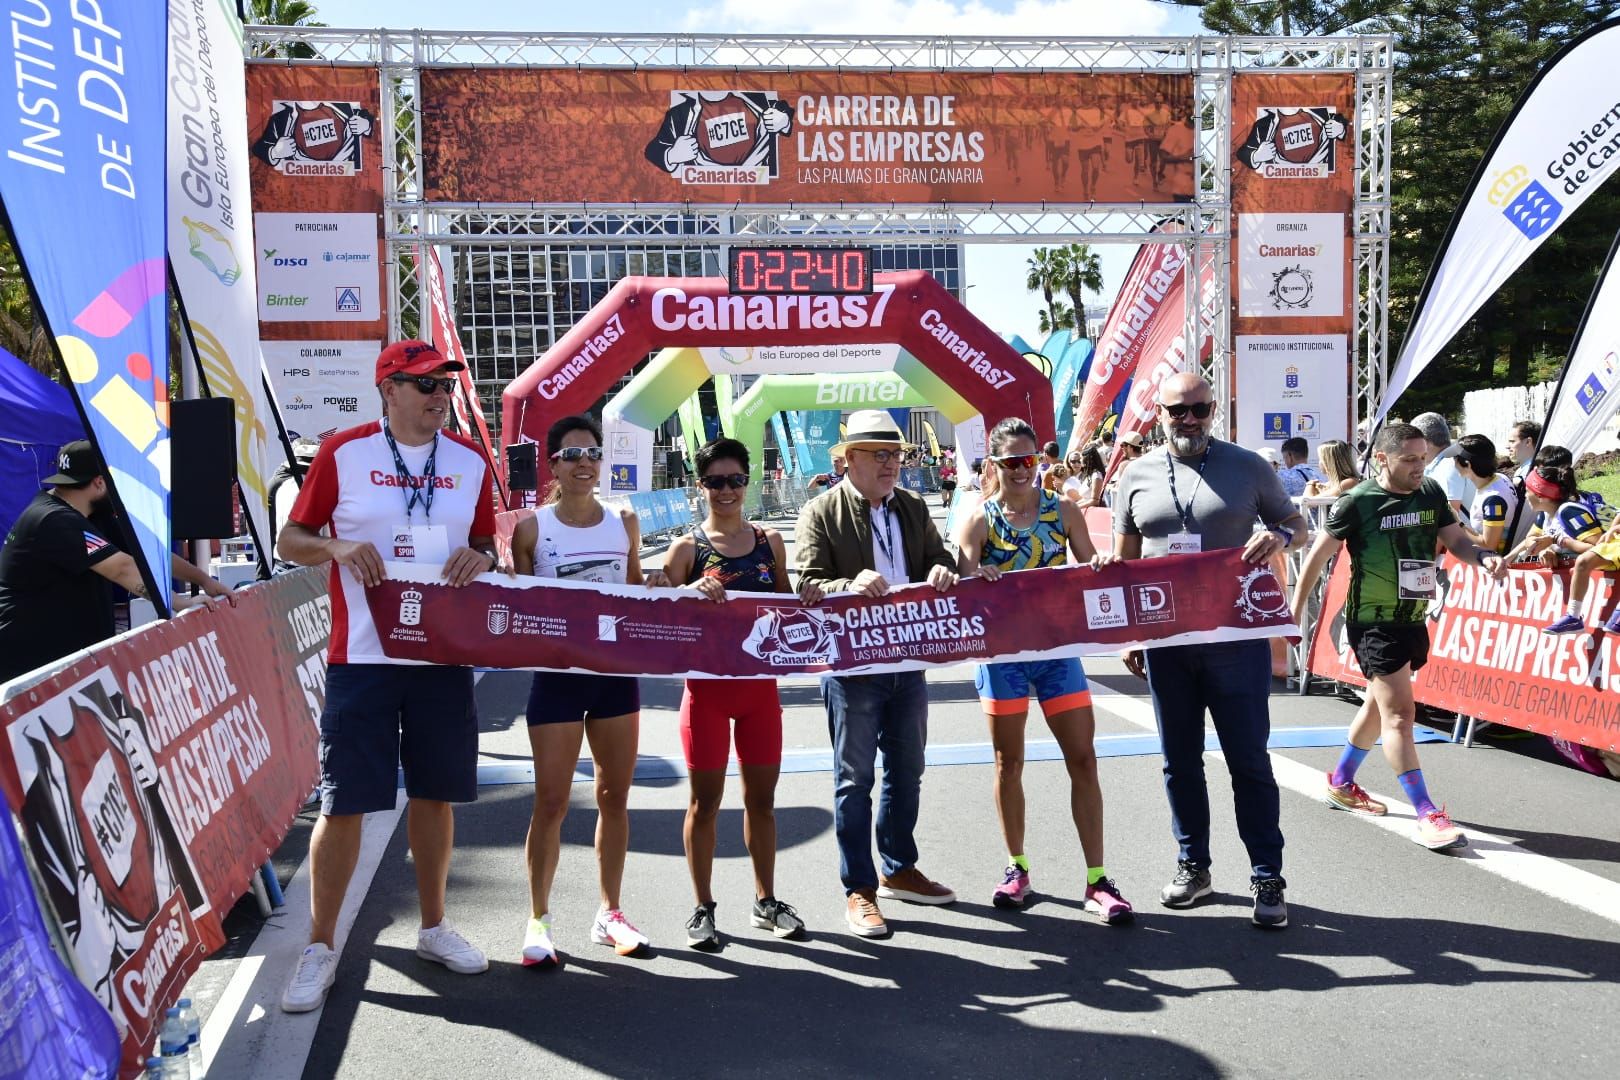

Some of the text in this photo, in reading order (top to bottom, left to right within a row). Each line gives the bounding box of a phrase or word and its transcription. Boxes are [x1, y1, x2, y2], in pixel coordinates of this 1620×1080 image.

[200, 67, 217, 103] del
[797, 95, 955, 126] CARRERA DE
[304, 122, 336, 142] #C7CE
[708, 116, 747, 142] #C7CE
[1283, 127, 1313, 145] #C7CE
[209, 106, 231, 191] Europea
[797, 131, 985, 163] LAS EMPRESAS
[97, 133, 135, 200] DE
[285, 161, 353, 176] Canarias7
[684, 167, 765, 184] Canarias7
[798, 167, 984, 184] LAS PALMAS DE GRAN CANARIA
[1265, 164, 1324, 177] Canarias7
[1563, 169, 1590, 196] de
[217, 195, 235, 231] Isla
[295, 223, 338, 232] PATROCINAN
[1276, 223, 1308, 232] ORGANIZA
[335, 252, 371, 263] cajamar
[1259, 243, 1323, 258] Canarias7
[738, 251, 863, 290] 0:22:40
[266, 294, 309, 306] Binter
[651, 284, 896, 332] Canarias7
[300, 348, 341, 358] COLABORAN
[537, 312, 626, 401] Canarias7
[780, 350, 820, 361] Europea
[822, 348, 838, 358] del
[841, 348, 881, 359] Deporte
[919, 308, 1016, 390] Canarias7
[1248, 342, 1334, 351] PATROCINIO INSTITUCIONAL
[283, 368, 311, 377] HPS
[323, 397, 358, 405] POWER
[1449, 563, 1564, 622] CARRERA
[513, 612, 567, 624] Ayuntamiento
[845, 596, 960, 629] CARRERA DE
[526, 620, 538, 628] Las
[849, 615, 985, 649] LAS EMPRESAS
[1432, 612, 1480, 663] LAS
[772, 654, 830, 665] Canarias7
[853, 639, 987, 661] LAS PALMAS DE GRAN CANARIA
[1425, 663, 1449, 692] LAS
[1450, 667, 1502, 706] PALMAS
[1503, 680, 1523, 710] DE
[1526, 684, 1572, 720] GRAN
